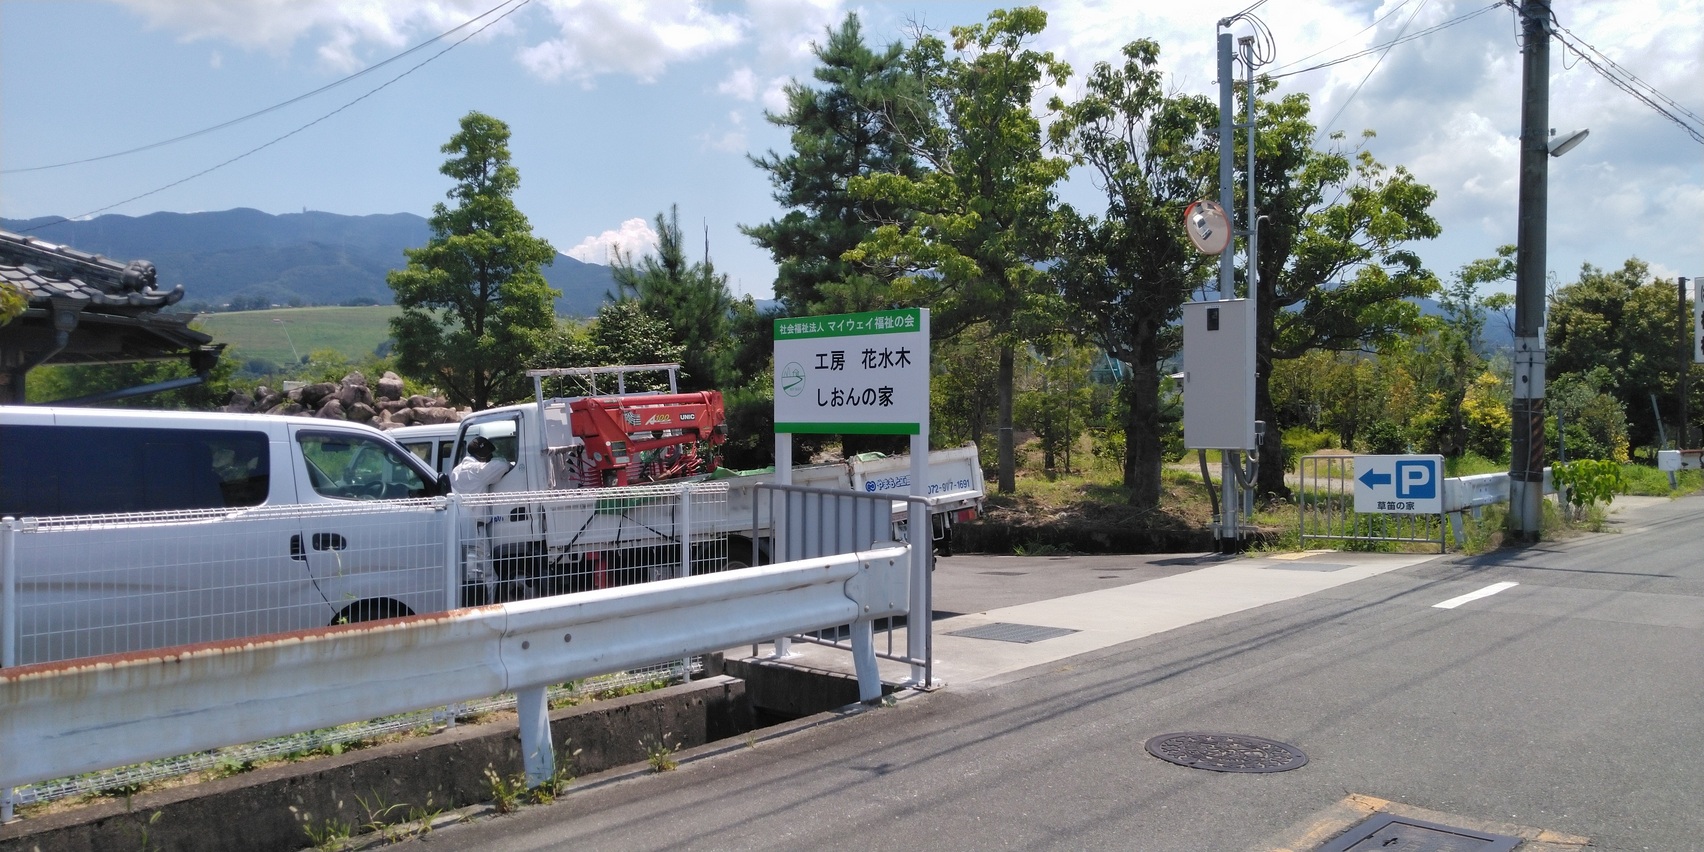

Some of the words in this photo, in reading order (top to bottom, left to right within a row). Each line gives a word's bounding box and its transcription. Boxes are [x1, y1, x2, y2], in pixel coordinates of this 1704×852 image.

[780, 322, 825, 335] 社会福祉法人
[828, 314, 915, 332] マイウェイ福祉の会
[814, 350, 846, 371] 工房
[861, 346, 912, 370] 花水木
[817, 386, 894, 407] しおんの家
[1402, 464, 1430, 495] P
[1377, 501, 1415, 511] 草笛の家
